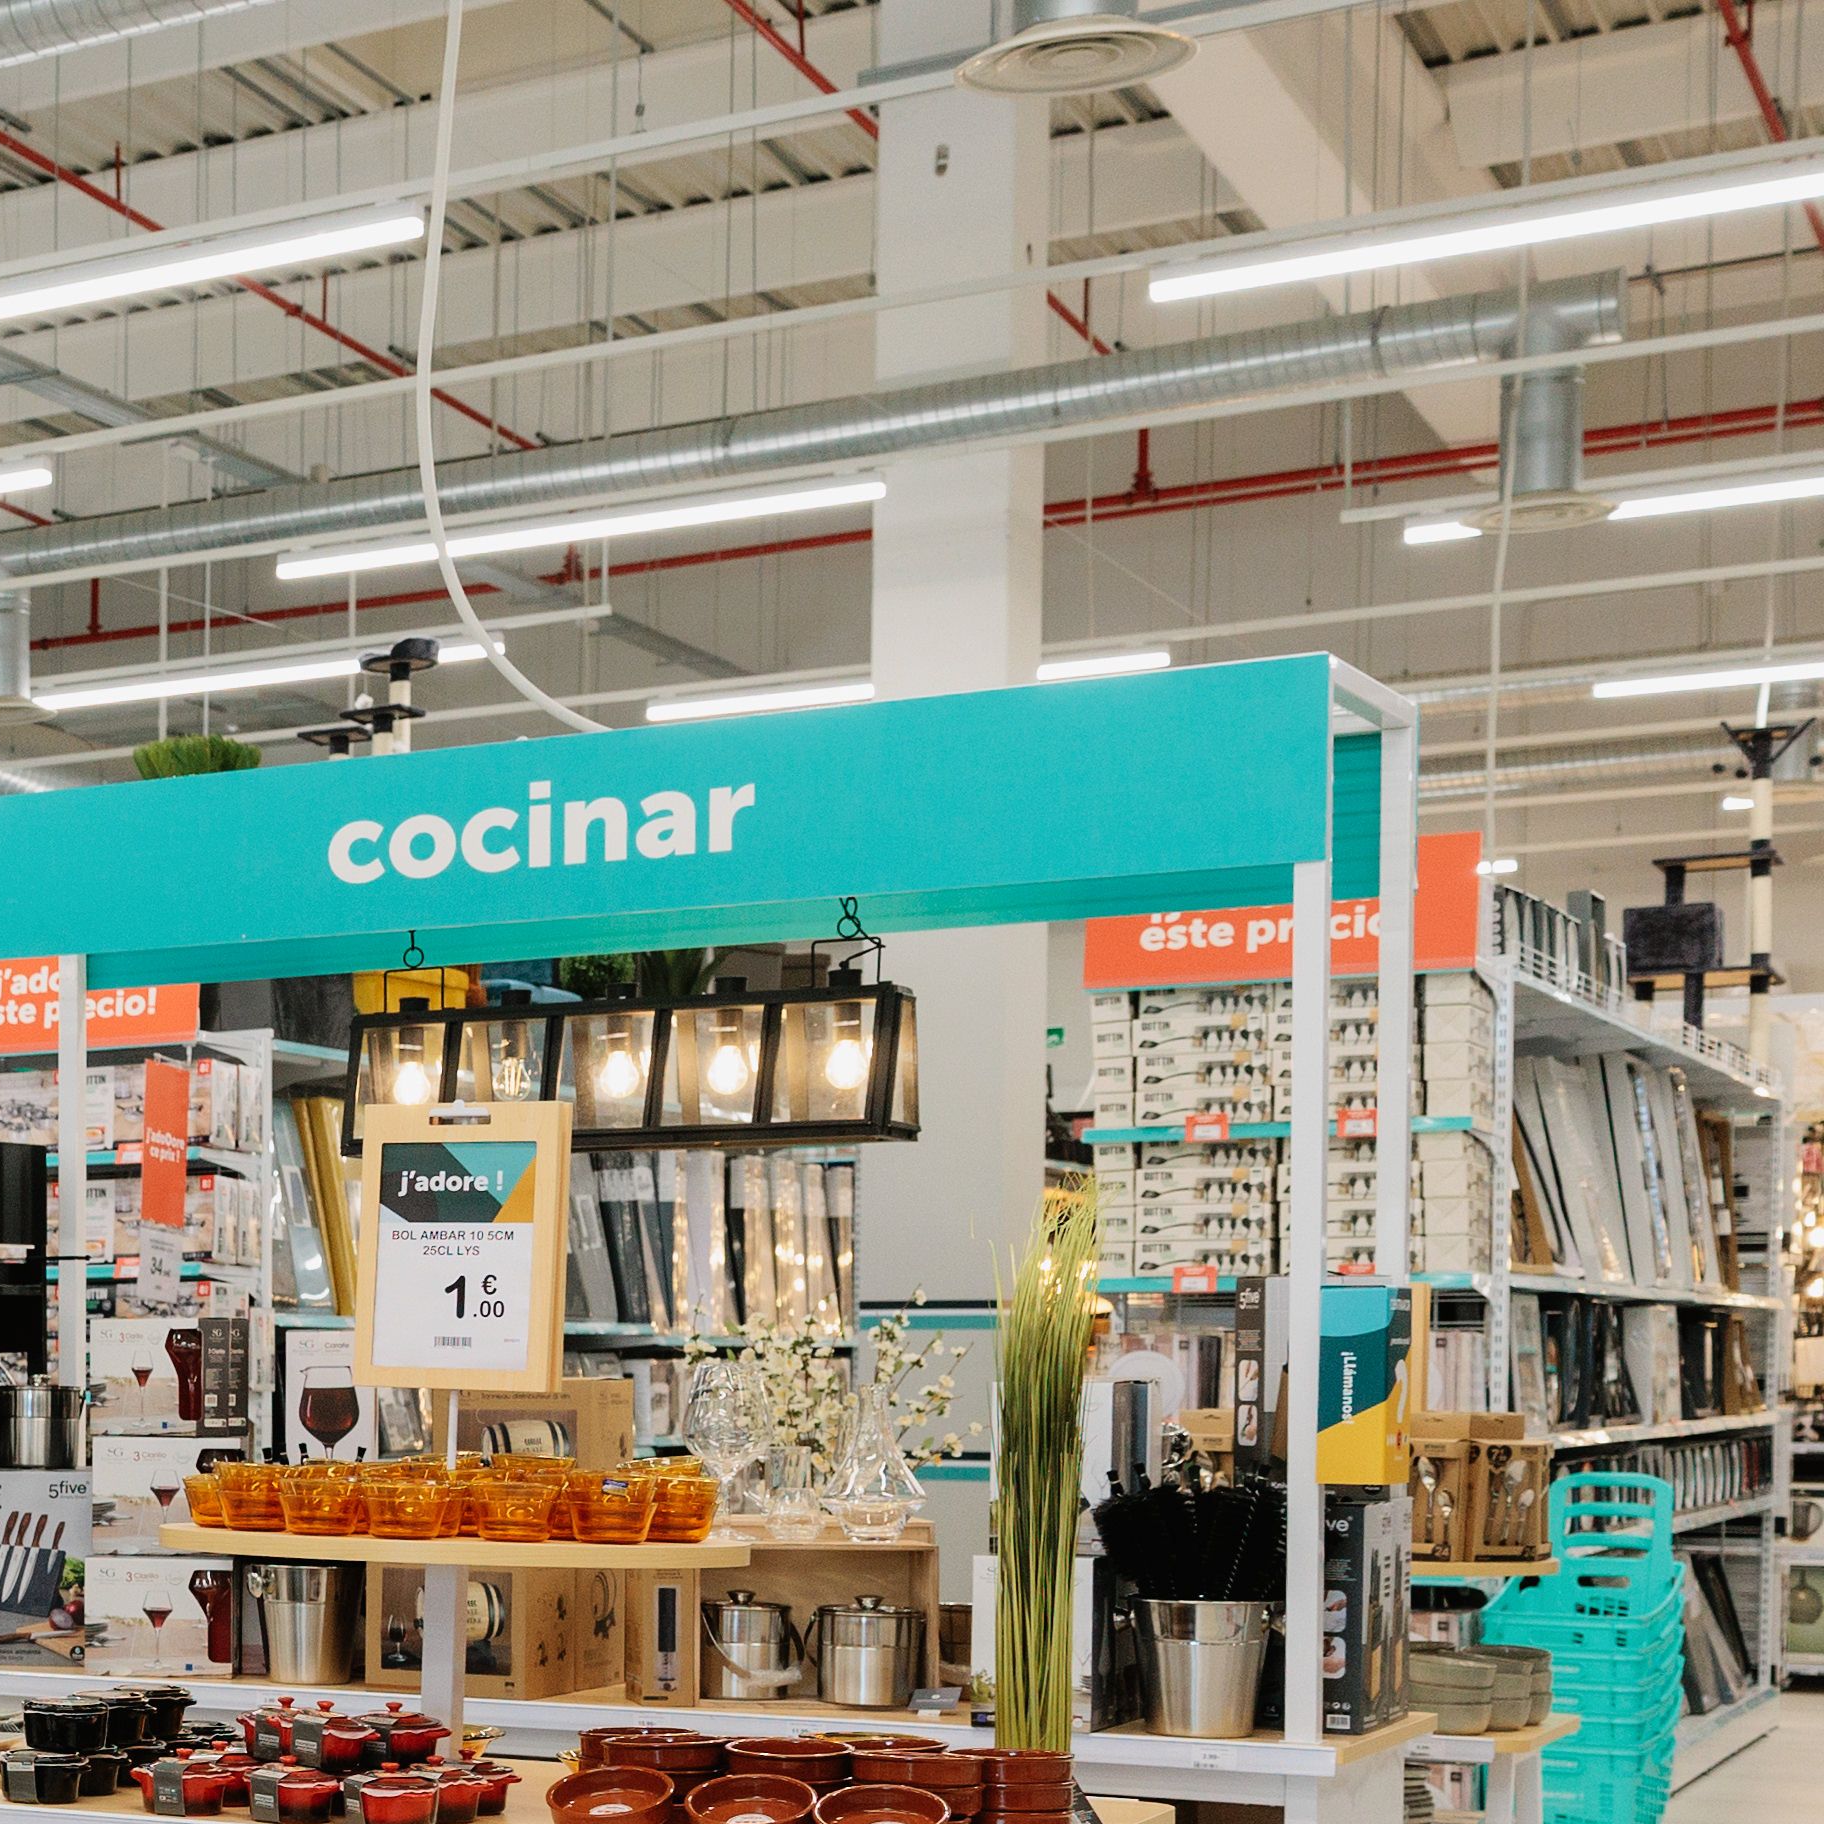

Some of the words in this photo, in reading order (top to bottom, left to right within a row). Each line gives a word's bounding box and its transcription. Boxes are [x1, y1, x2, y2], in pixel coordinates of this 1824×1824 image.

[327, 780, 755, 884] cocinar
[1139, 914, 1234, 951] este
[43, 986, 157, 1029] pecio!
[397, 1170, 489, 1197] j'adore
[392, 1231, 416, 1240] BOL
[420, 1231, 466, 1240] AMBAR
[423, 1246, 453, 1256] 25CL
[457, 1246, 480, 1256] LYS
[445, 1275, 466, 1319] 1
[481, 1274, 497, 1295] €
[1340, 1351, 1358, 1424] ¡Llámanos!
[48, 1480, 87, 1499] 5five
